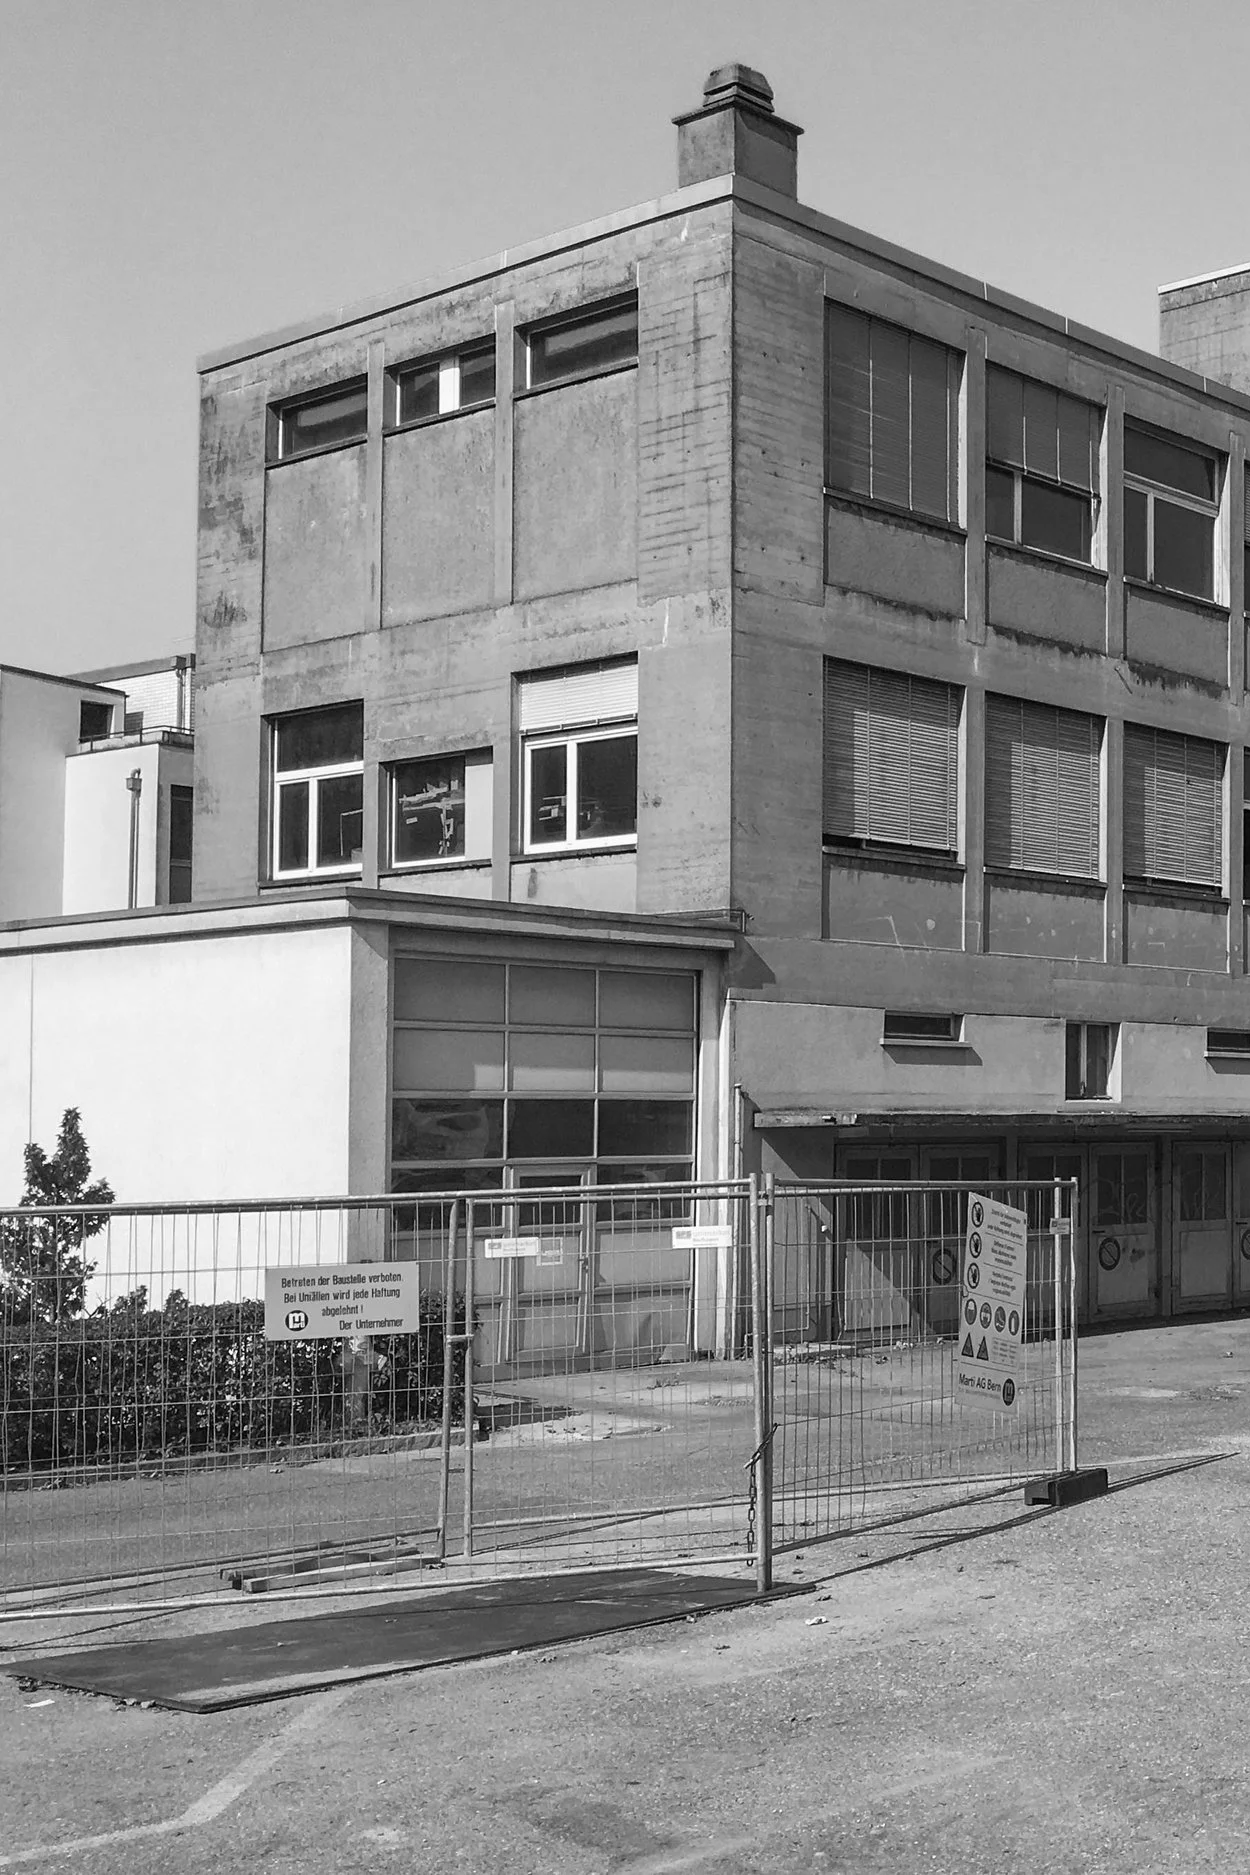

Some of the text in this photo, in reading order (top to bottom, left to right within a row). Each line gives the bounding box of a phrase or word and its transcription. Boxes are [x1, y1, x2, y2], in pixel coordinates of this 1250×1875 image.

[281, 1277, 316, 1288] Betreten
[318, 1276, 330, 1286] der
[333, 1274, 366, 1285] Baustelle
[284, 1293, 297, 1303] Bei
[333, 1290, 351, 1300] wird
[353, 1289, 369, 1301] jede
[371, 1287, 401, 1299] Haftung
[322, 1305, 359, 1317] abgelehnt
[339, 1318, 404, 1331] Der Unternehmer
[959, 1373, 1002, 1392] Marti AG Bern
